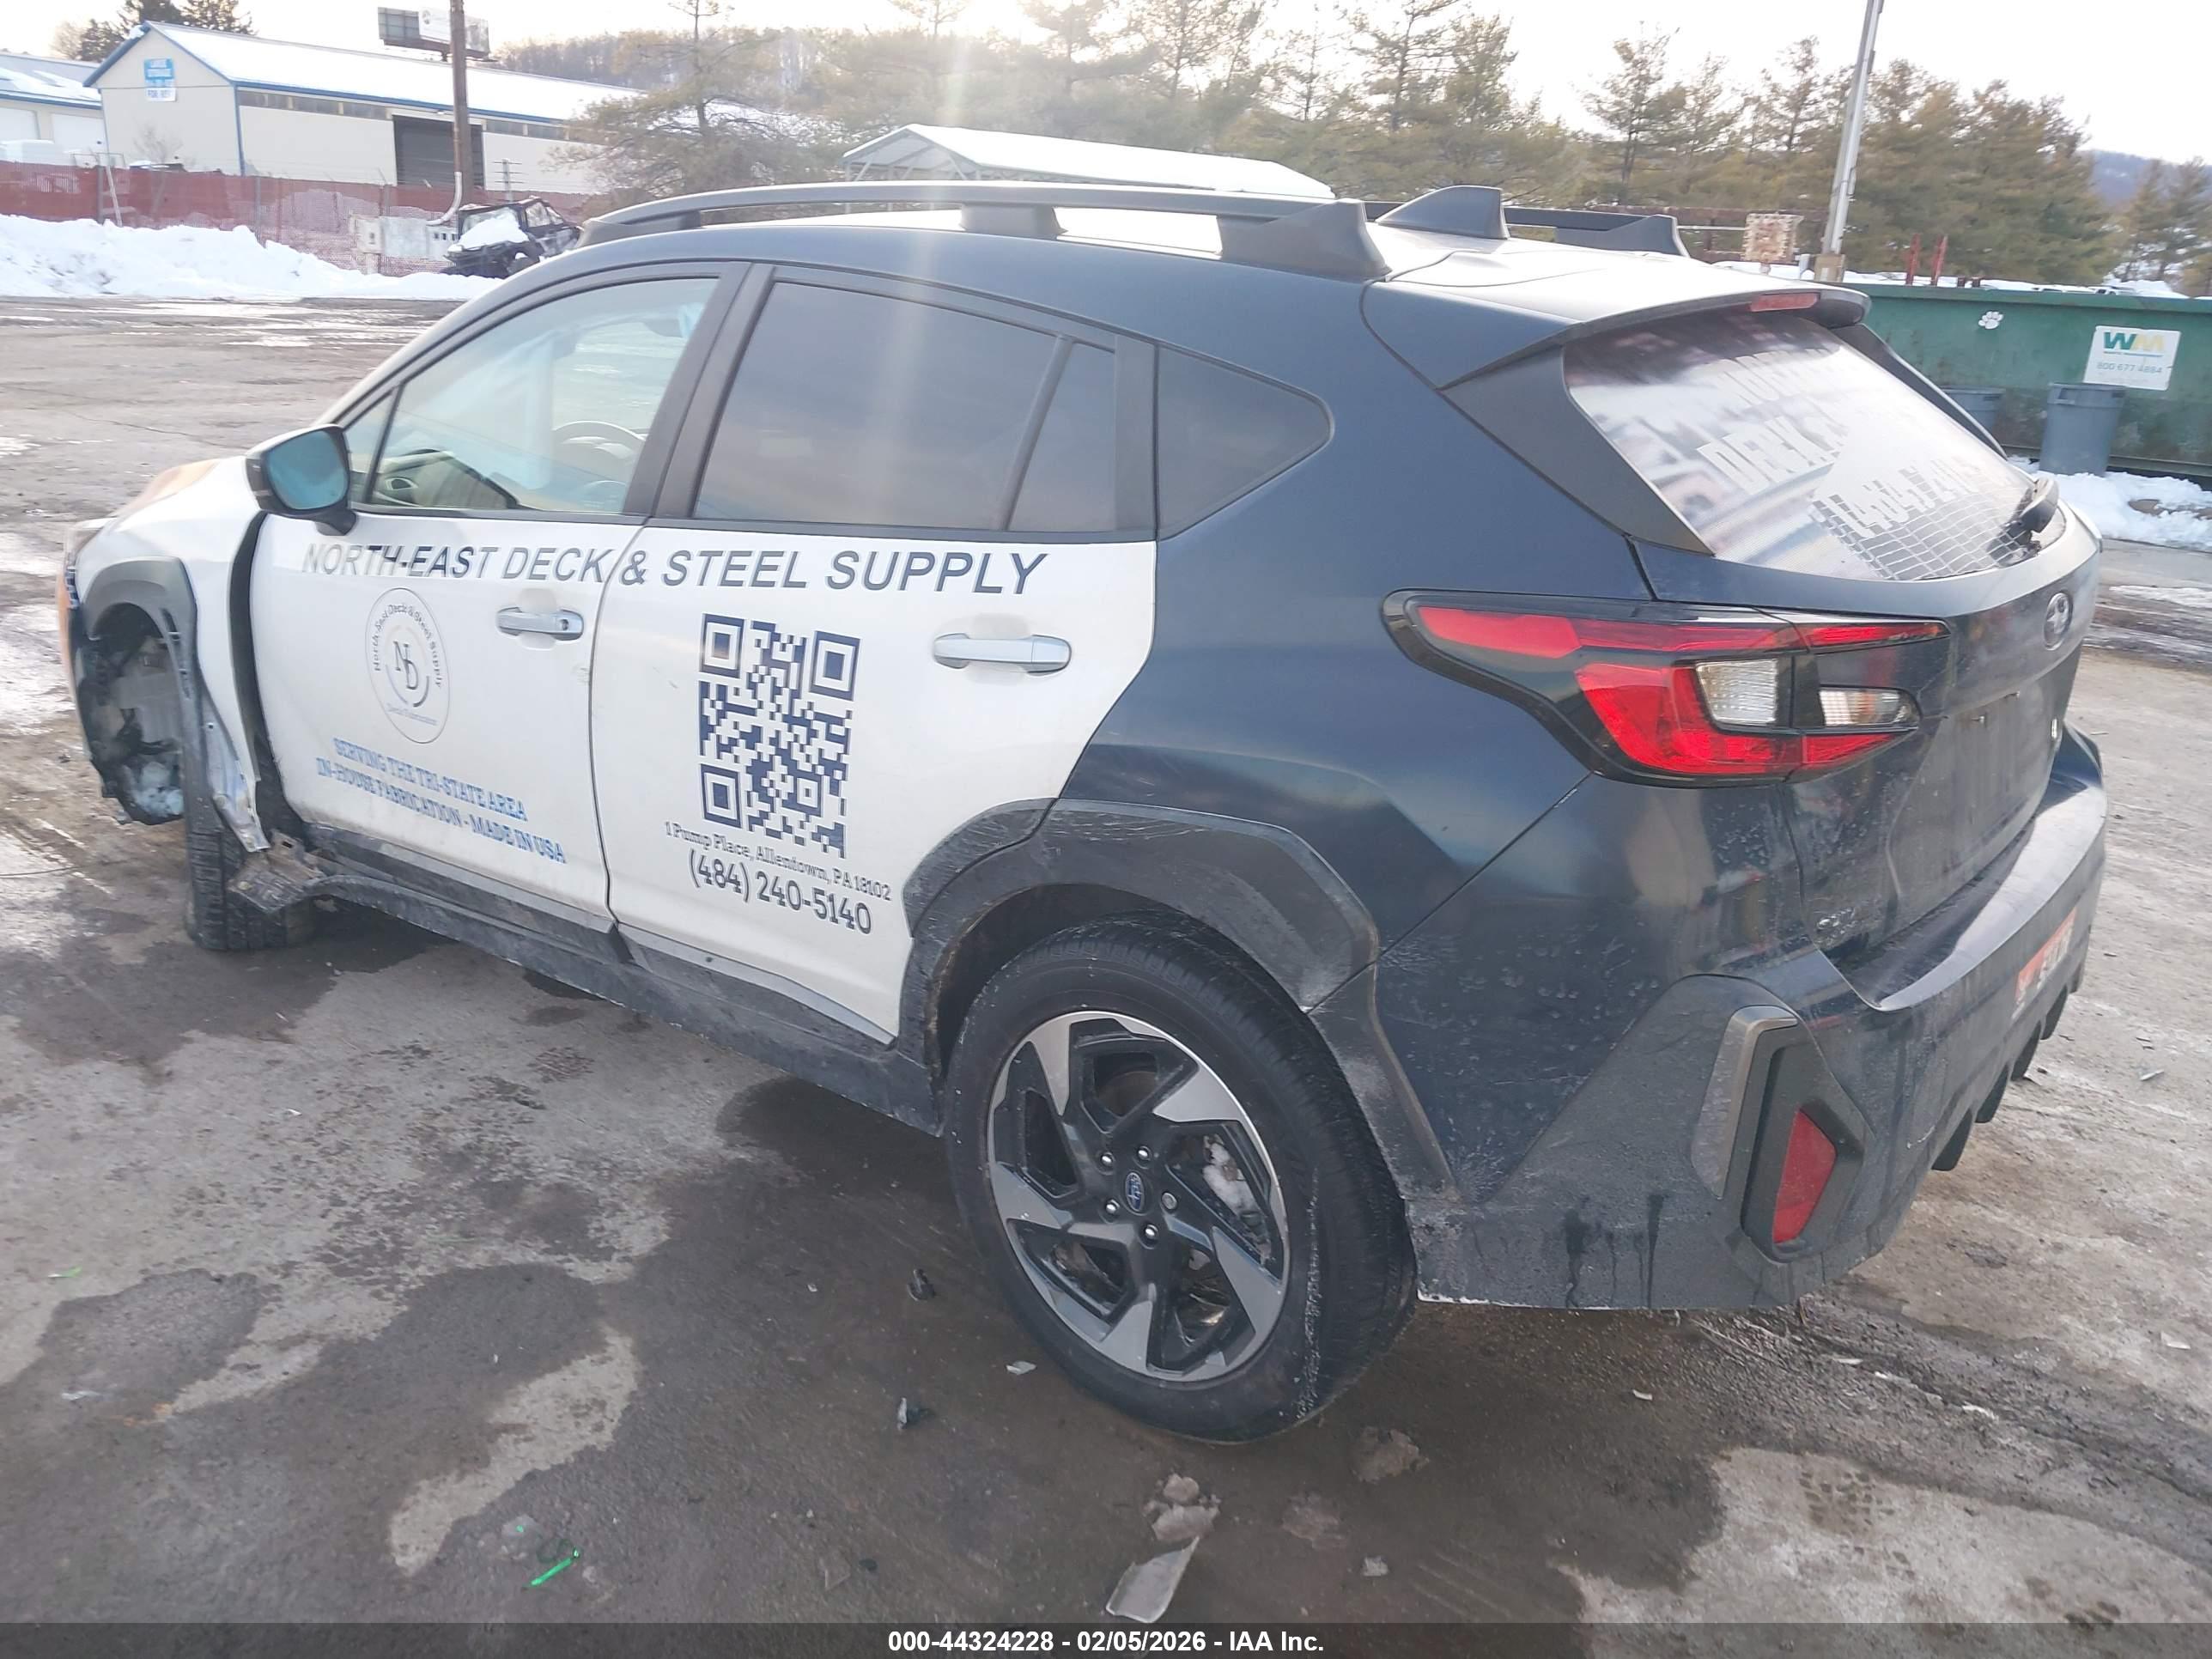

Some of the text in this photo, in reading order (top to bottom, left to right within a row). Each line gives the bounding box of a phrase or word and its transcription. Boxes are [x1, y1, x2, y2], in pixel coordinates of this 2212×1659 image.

[2103, 331, 2165, 351] WM
[302, 543, 1049, 594] NORTH-EAST DECK & STEEL SUPPLY
[333, 737, 529, 822] SERVING THE TRI-STATE AREA
[376, 777, 465, 828] FABRICATION
[469, 813, 514, 849] MADE
[514, 828, 534, 853] IN
[533, 835, 567, 864] USA
[665, 821, 892, 902] 1 Pump Place, Allentown, PA 18102
[690, 848, 872, 935] (484) 240-5140
